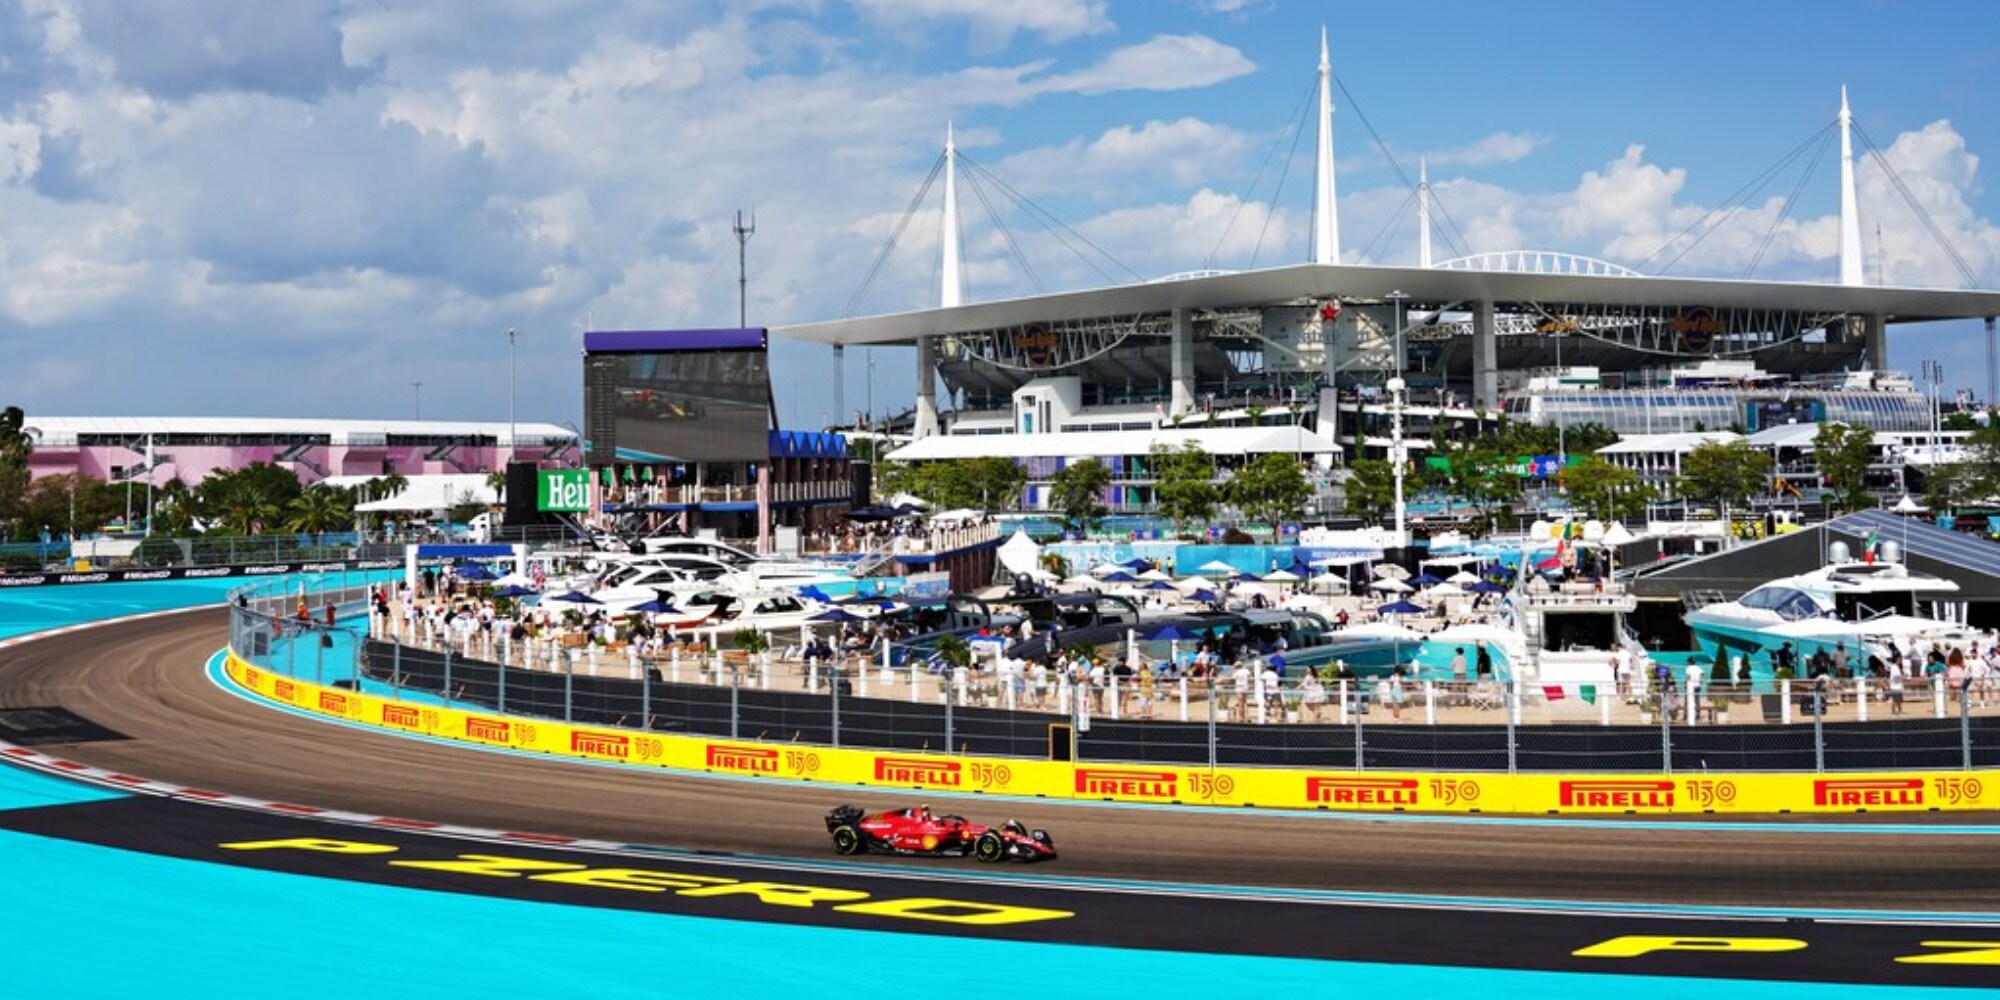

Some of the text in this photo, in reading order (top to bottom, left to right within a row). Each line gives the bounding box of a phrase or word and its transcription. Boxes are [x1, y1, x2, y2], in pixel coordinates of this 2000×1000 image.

[383, 704, 419, 728] PIRELLI
[466, 716, 510, 743] PIRELLI
[571, 731, 629, 758] PIRELLI
[706, 744, 820, 775] PIRELLI 150
[874, 757, 1011, 789] PIRELLI 150
[1075, 769, 1234, 799] PIRELLI 150
[1306, 777, 1480, 806] PIRELLI 150
[1559, 780, 1736, 807] PIRELLI 150
[1813, 778, 1983, 806] PIRELLI 150
[218, 837, 1076, 925] P ZERO
[1570, 935, 1809, 957] P
